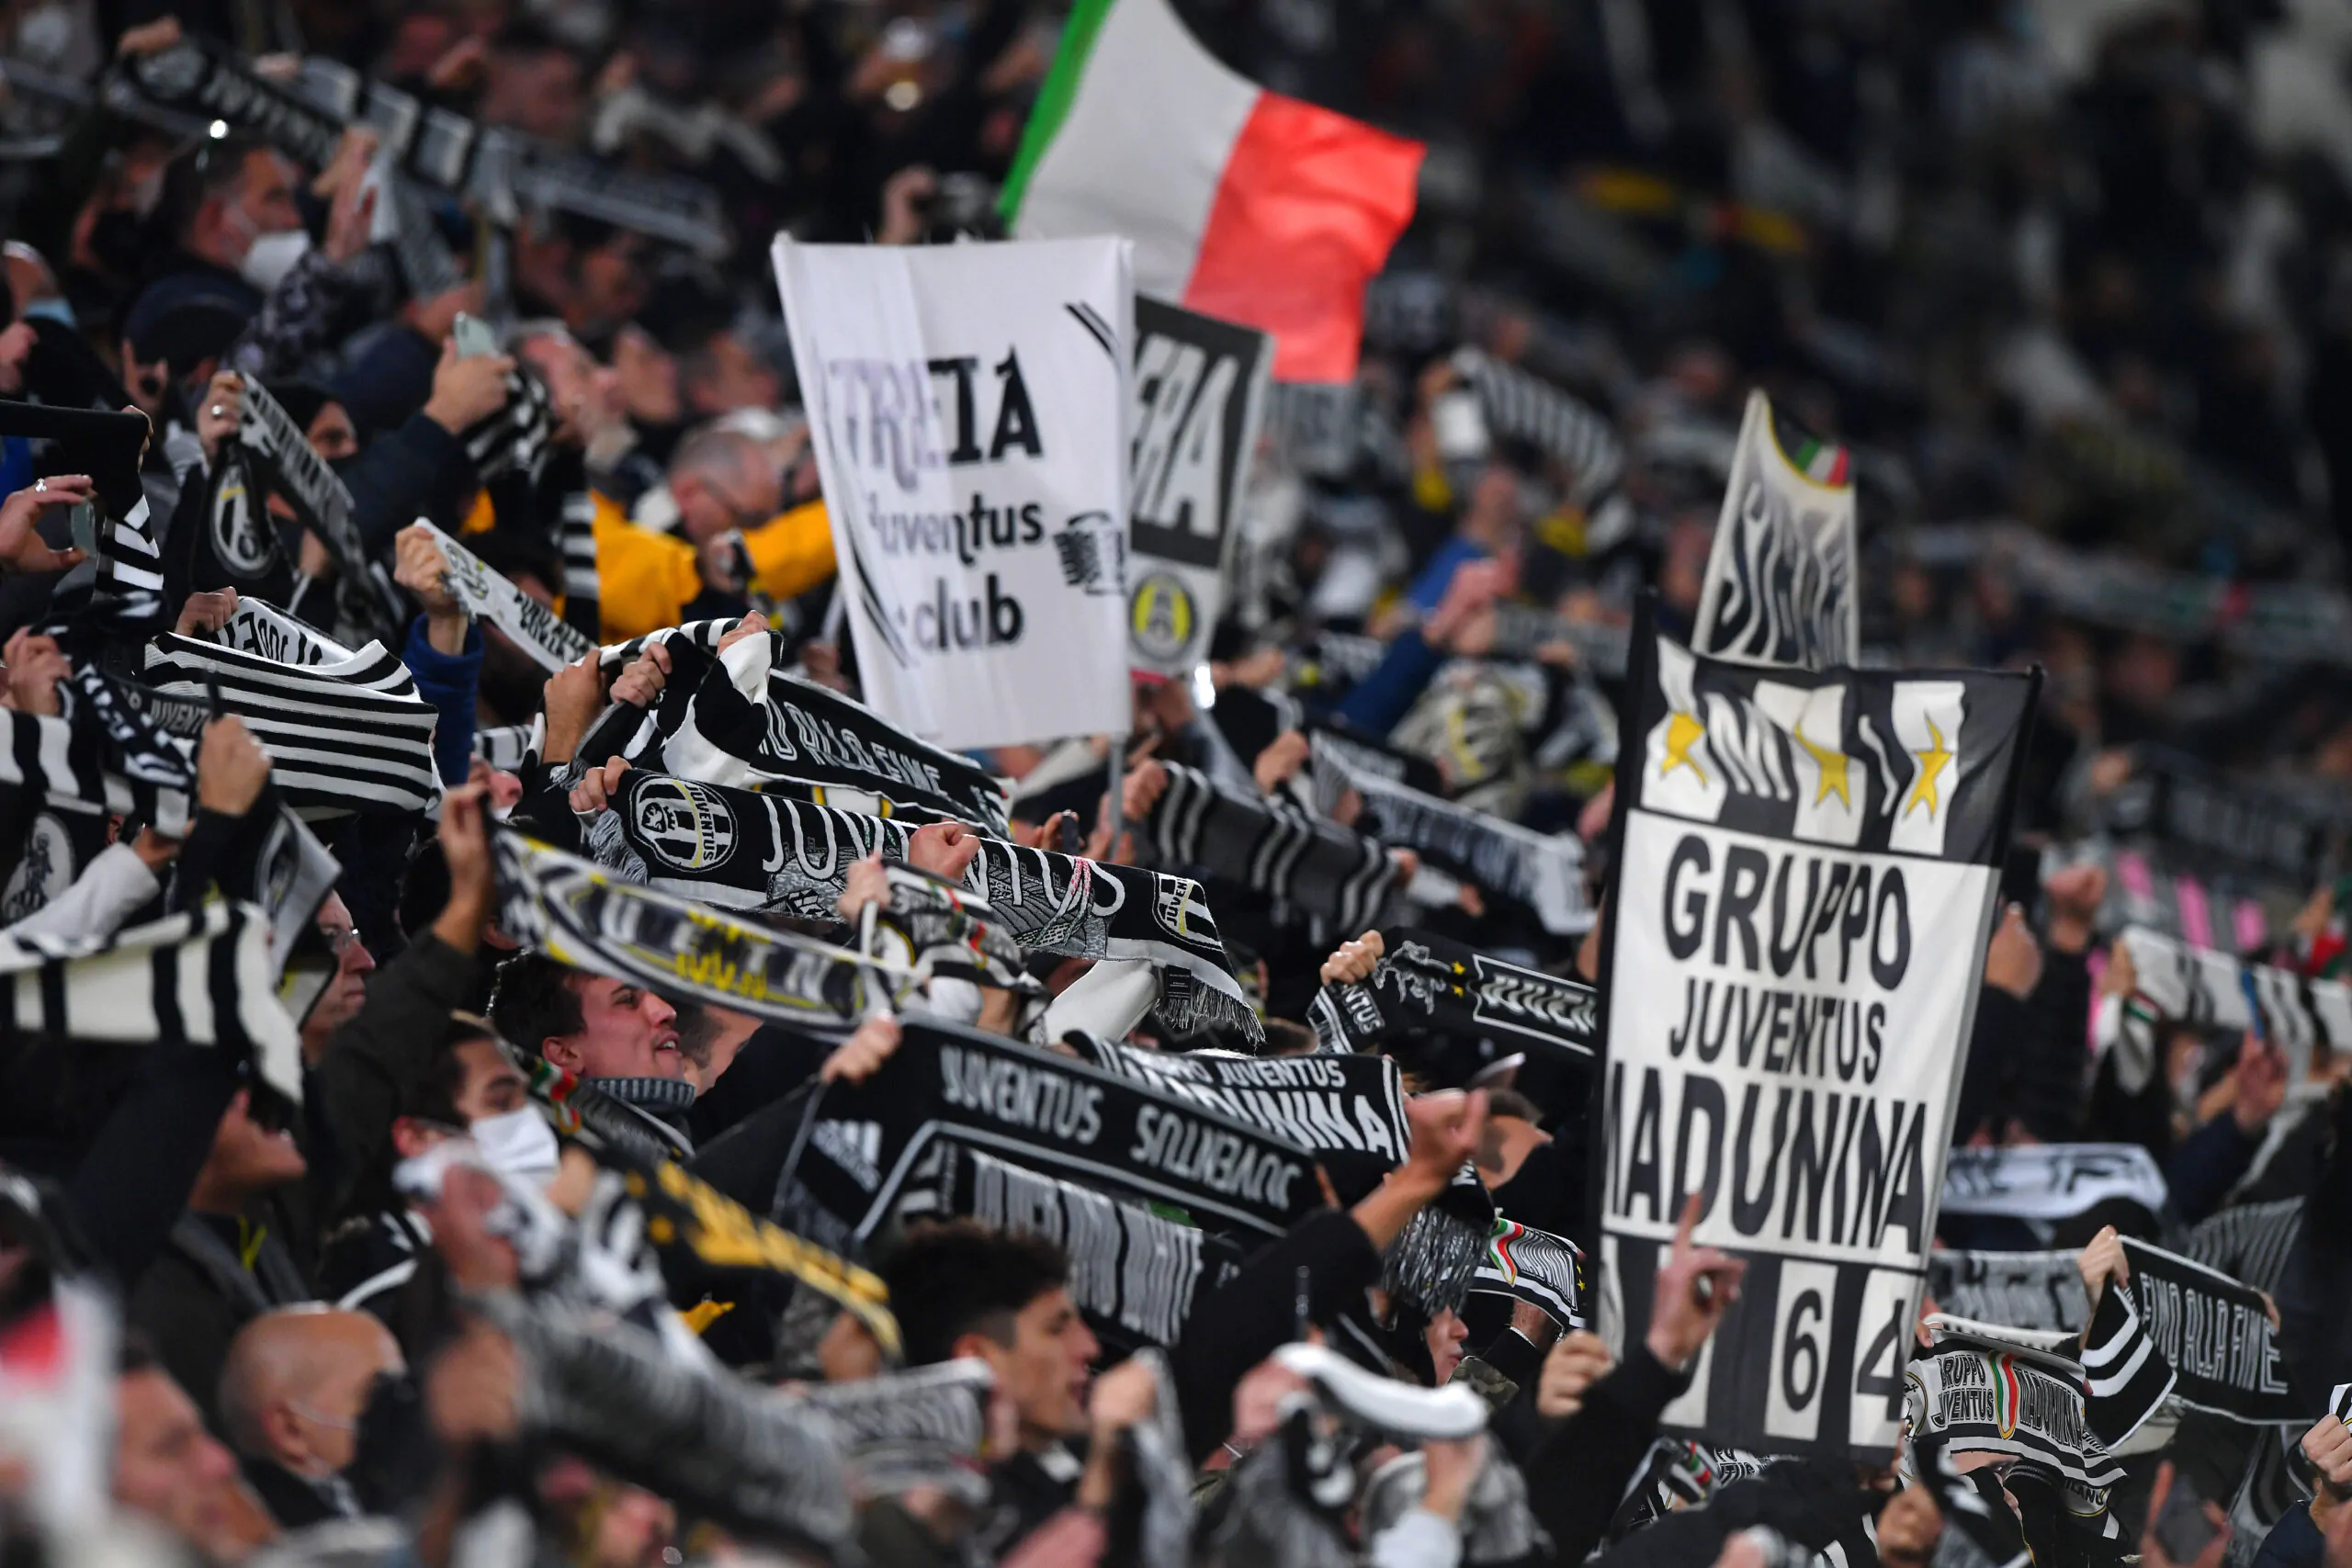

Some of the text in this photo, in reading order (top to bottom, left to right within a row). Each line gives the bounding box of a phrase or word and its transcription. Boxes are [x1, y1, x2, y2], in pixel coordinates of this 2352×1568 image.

[915, 571, 1023, 653] club
[685, 784, 716, 862] JUVENTUS
[762, 795, 1126, 917] JUVNTUS
[1163, 877, 1193, 927] JUVEN
[1663, 833, 1912, 991] GRUPPO
[1341, 984, 1385, 1035] NTUS
[1668, 976, 1887, 1085] JUVENTUS
[939, 1043, 1103, 1145] JUVENTUS
[1216, 1058, 1347, 1089] JUVENTUS
[2182, 1288, 2229, 1382] ALLA
[2229, 1303, 2289, 1394] FINE
[1930, 1387, 1994, 1428] JVENTUS
[2064, 1479, 2105, 1506] ILANO
